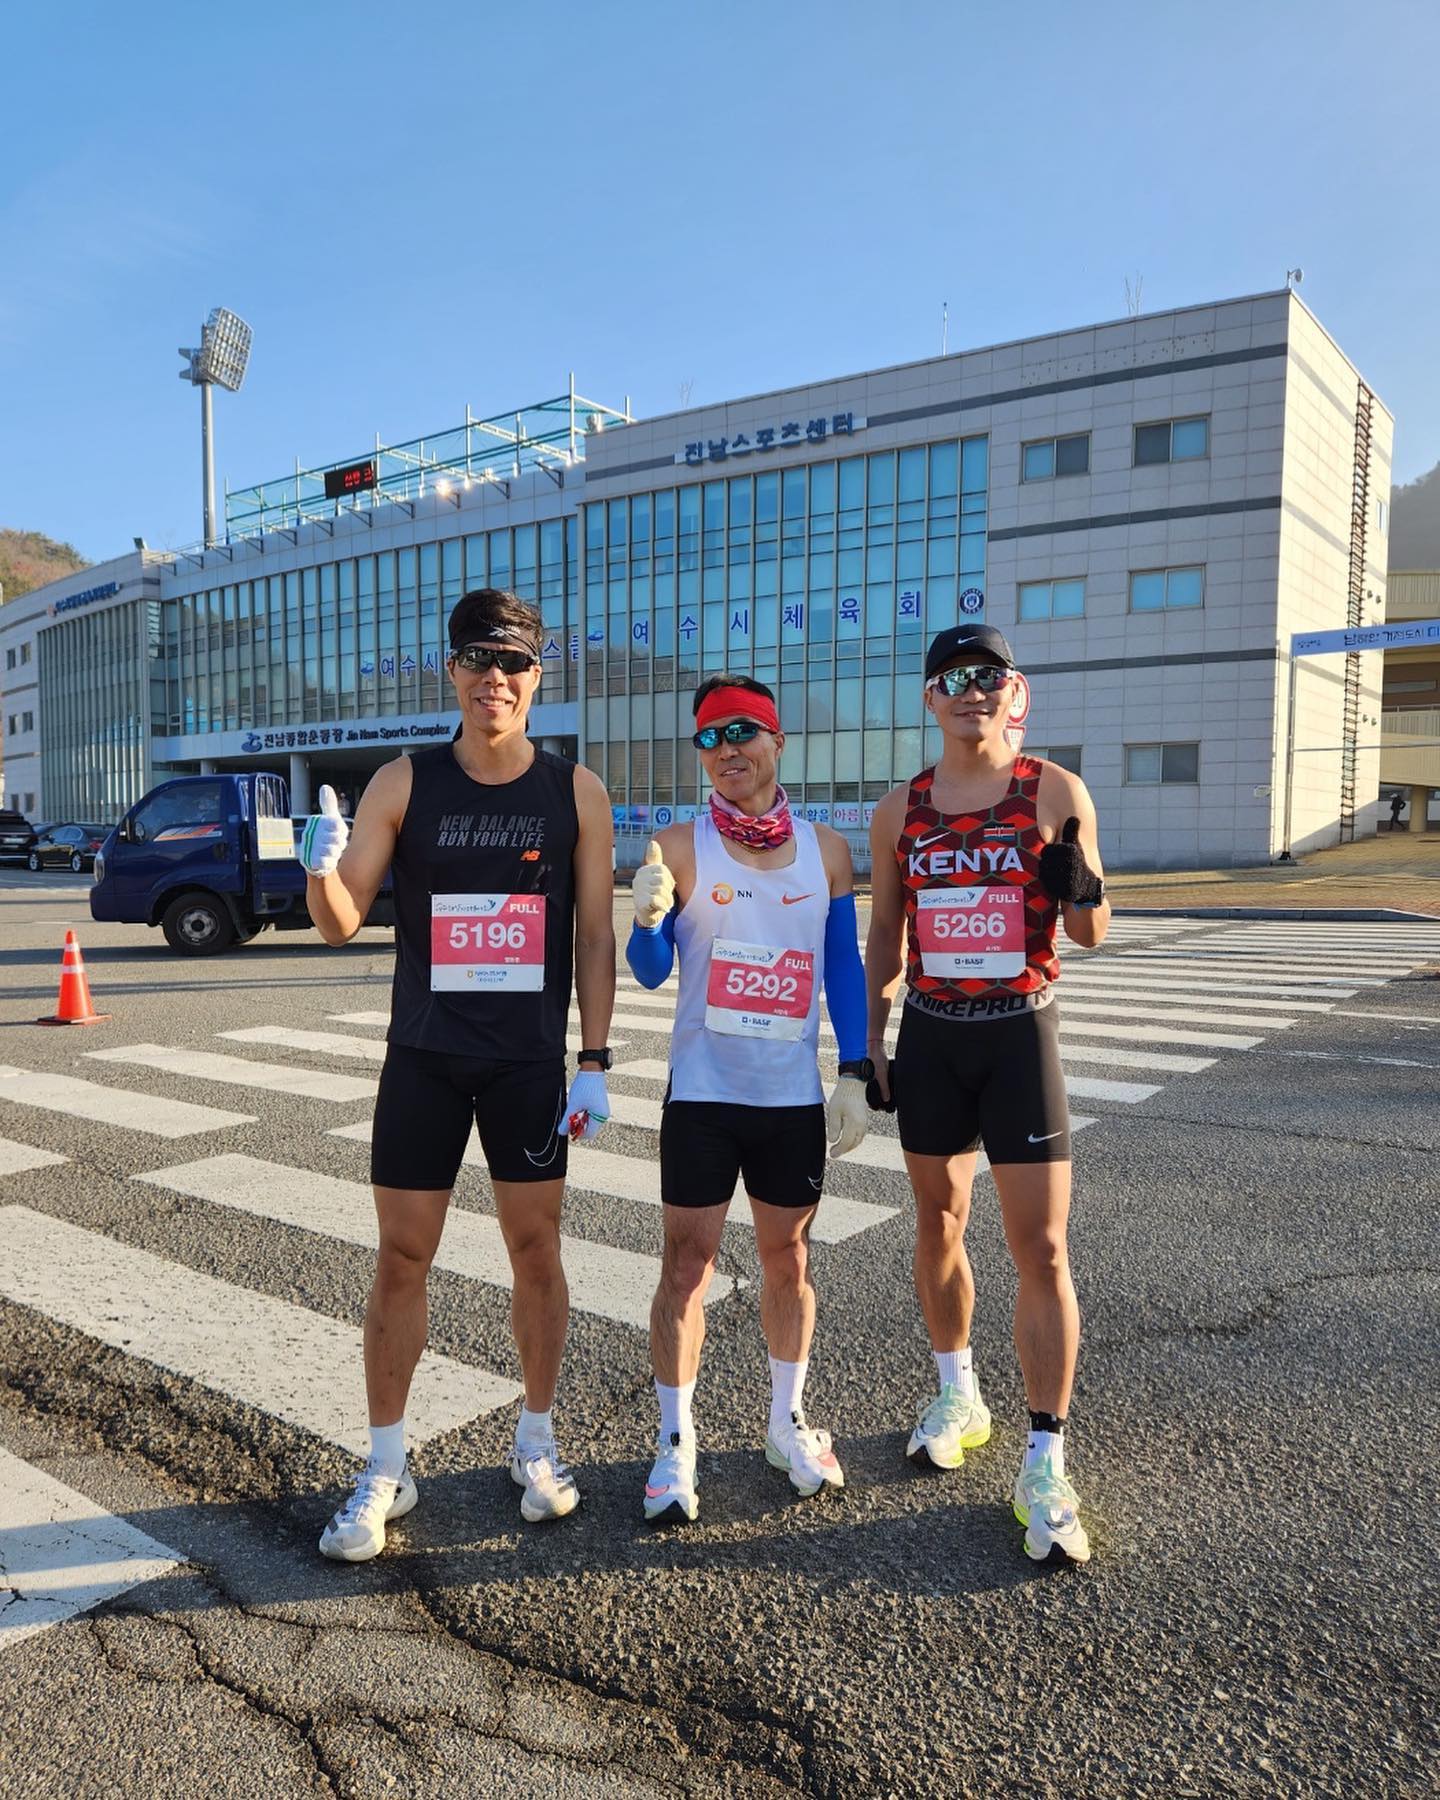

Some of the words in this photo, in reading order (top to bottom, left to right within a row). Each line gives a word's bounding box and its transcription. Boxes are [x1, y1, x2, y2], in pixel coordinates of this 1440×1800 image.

[685, 412, 854, 466] 진남스포츠센터
[264, 728, 344, 748] 진남종합운동장
[346, 730, 358, 740] Jin
[380, 727, 409, 739] Sports
[410, 724, 450, 736] Complex
[439, 815, 474, 831] NEW
[478, 815, 546, 832] BALANCE
[438, 831, 469, 847] RUN
[472, 831, 510, 847] YOUR
[511, 832, 544, 848] LIFE
[908, 847, 1024, 877] KENYA
[737, 890, 753, 898] NN
[988, 893, 1020, 904] FULL
[509, 903, 540, 914] FULL
[933, 912, 1007, 938] 5266
[449, 922, 527, 949] 5196
[785, 957, 811, 971] FULL
[725, 968, 798, 1003] 5292
[915, 989, 965, 1017] NIKE
